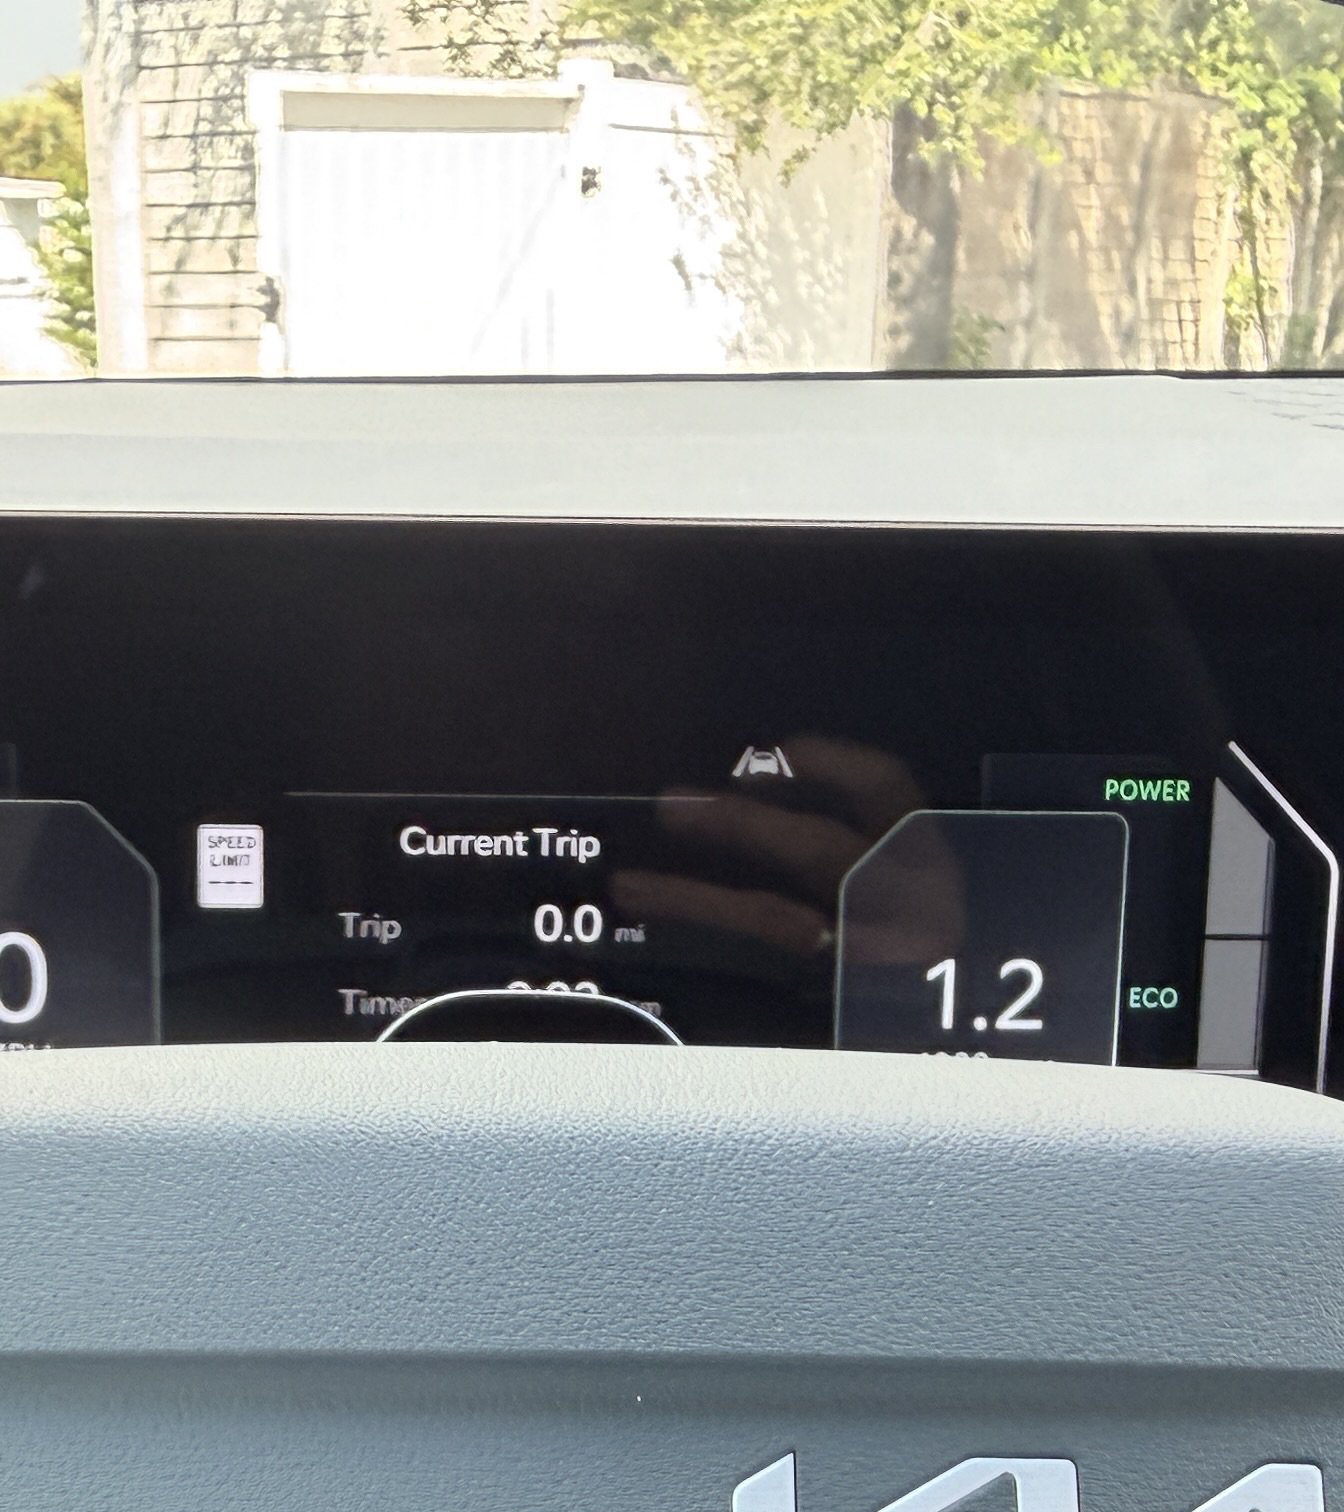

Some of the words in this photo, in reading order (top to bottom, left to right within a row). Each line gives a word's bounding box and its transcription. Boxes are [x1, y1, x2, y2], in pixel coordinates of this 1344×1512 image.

[1104, 779, 1191, 802] POWER
[207, 835, 257, 849] SPEED
[399, 825, 529, 858] Current
[533, 827, 601, 863] Trip
[337, 912, 402, 944] Trip
[533, 903, 603, 944] 0.0
[614, 924, 646, 943] mi
[925, 957, 1045, 1031] 1.2
[1128, 986, 1179, 1009] ECO
